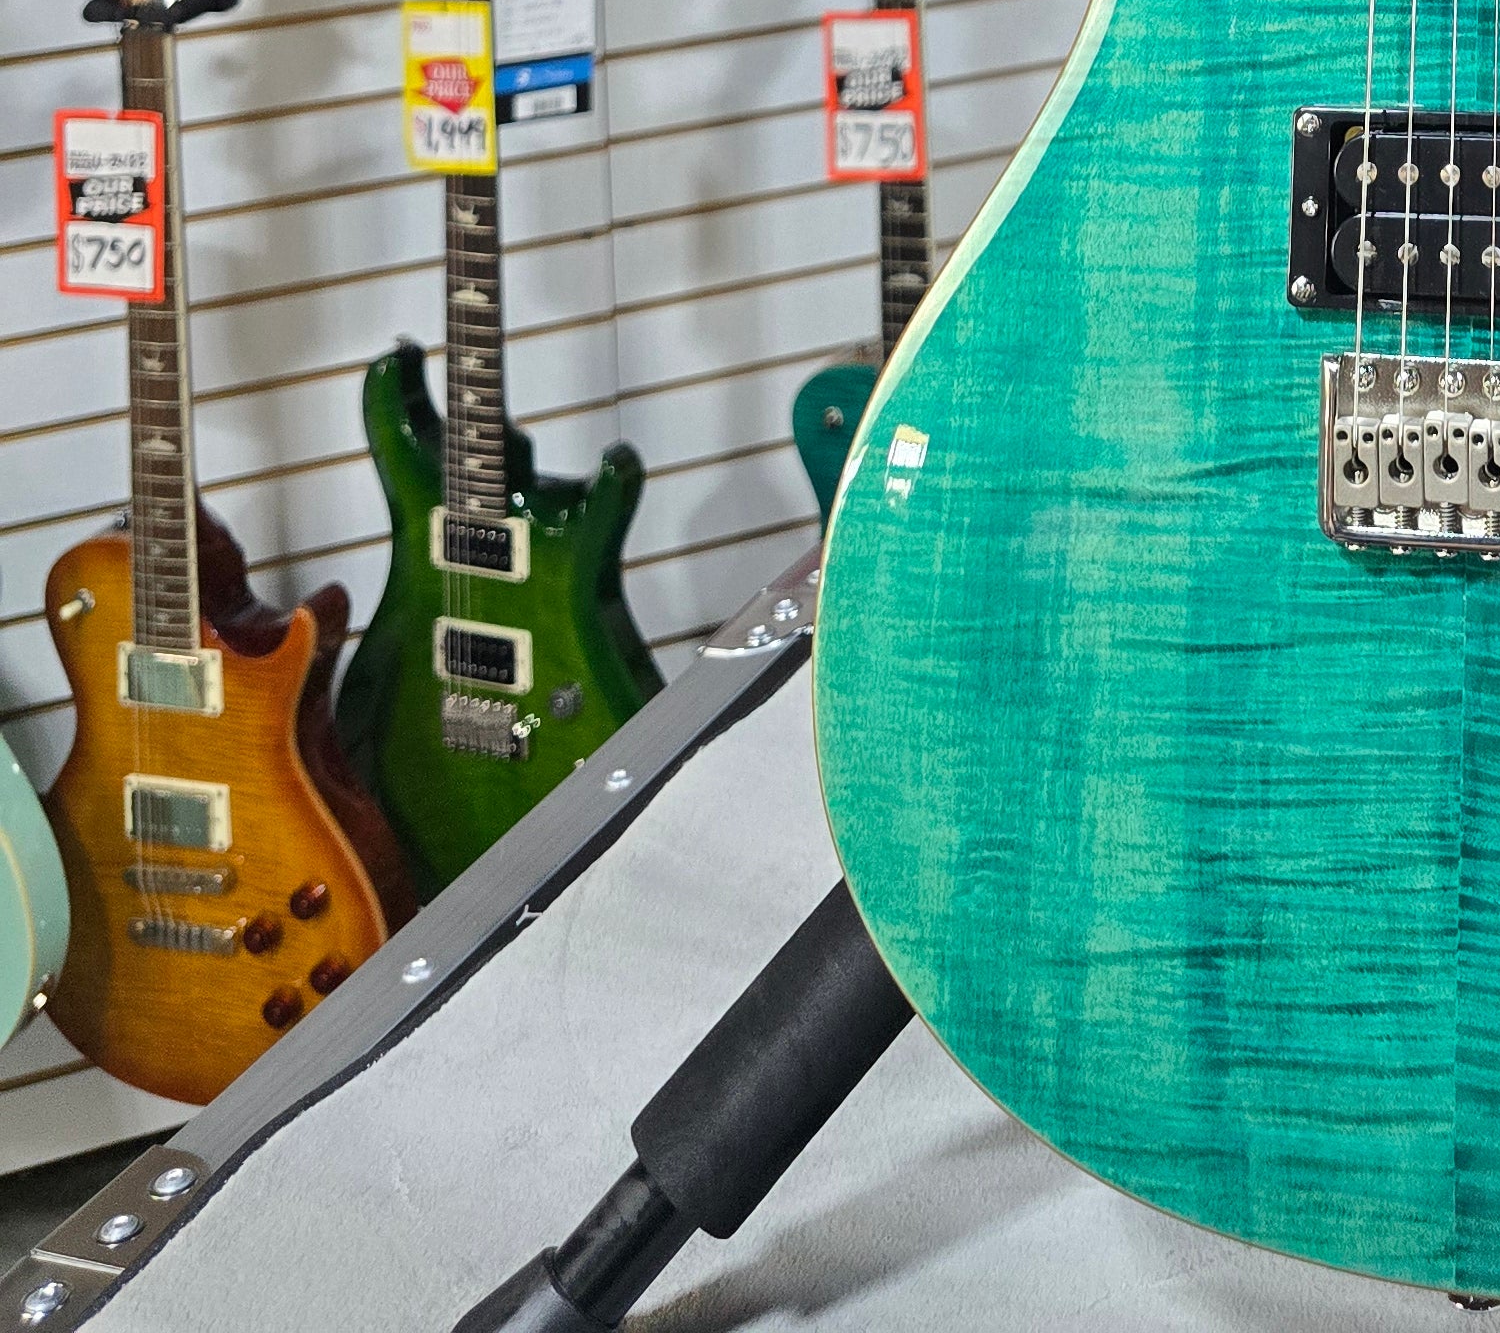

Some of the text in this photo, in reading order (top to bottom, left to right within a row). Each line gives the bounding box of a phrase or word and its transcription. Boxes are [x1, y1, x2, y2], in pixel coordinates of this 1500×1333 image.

[82, 176, 135, 198] OUR
[75, 191, 146, 217] PRICE
[71, 233, 146, 273] $750
